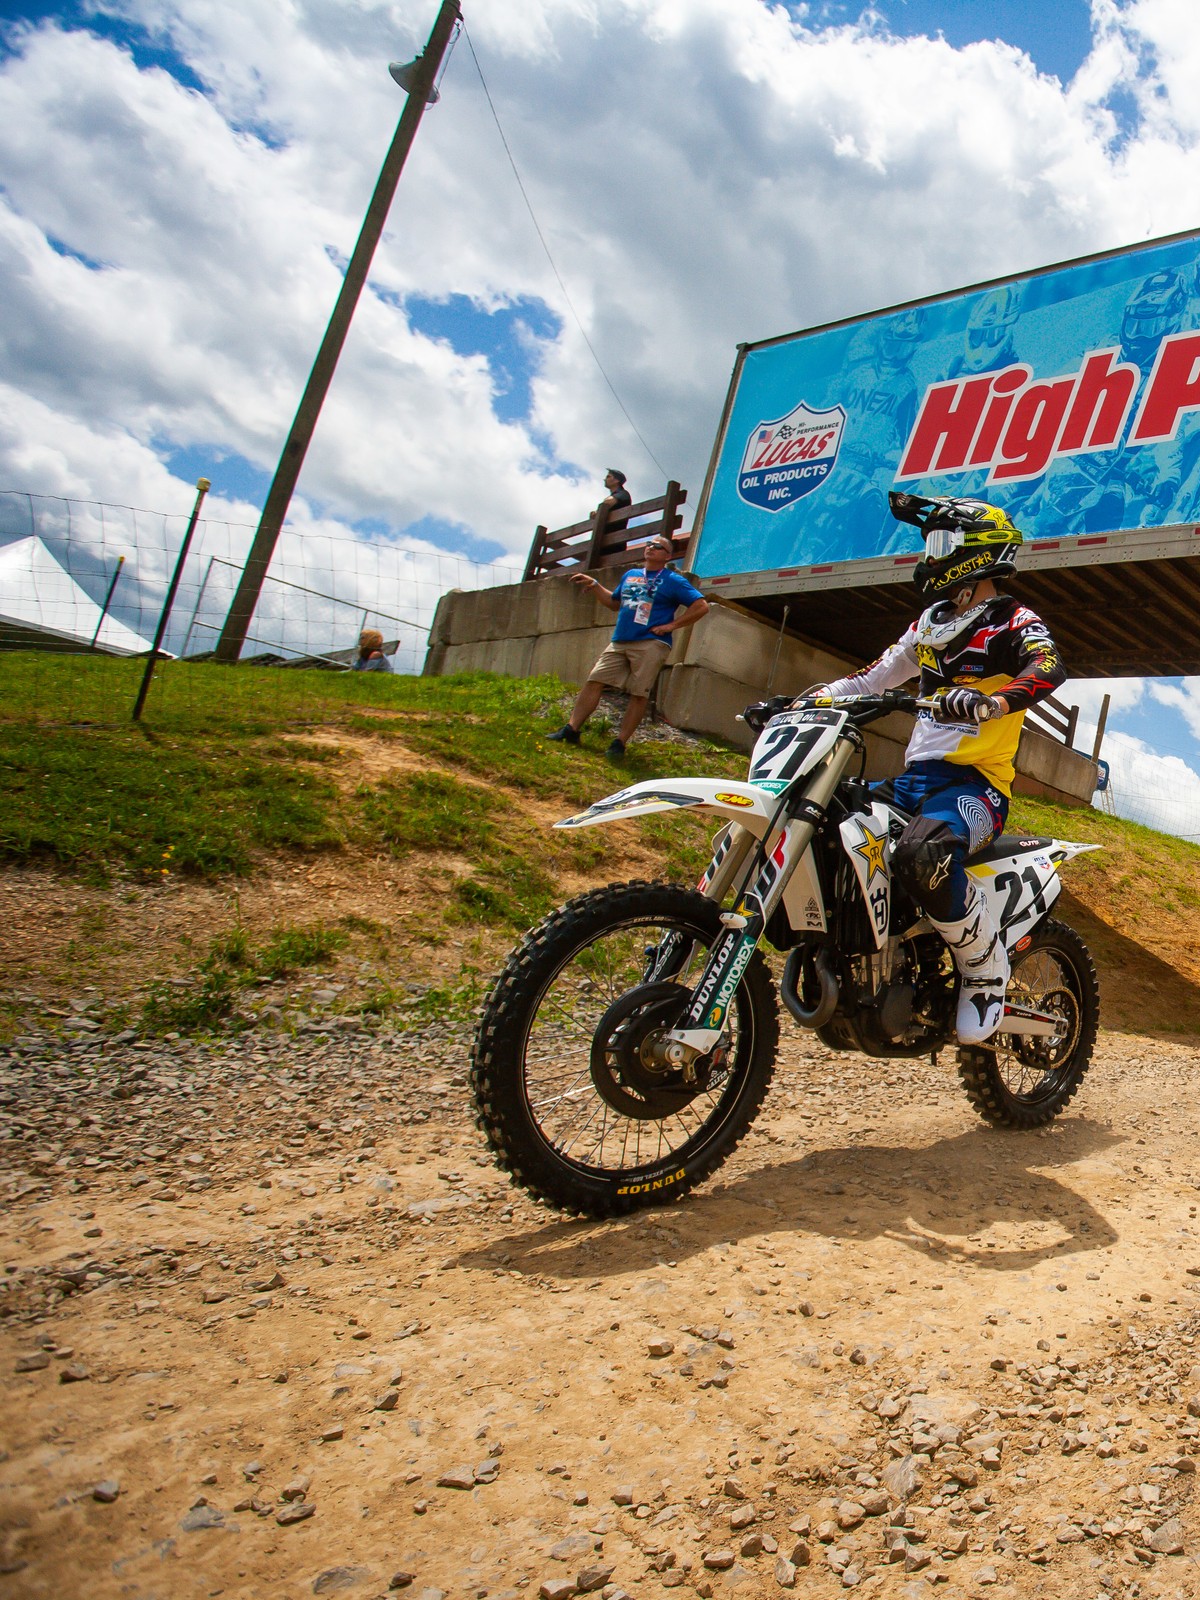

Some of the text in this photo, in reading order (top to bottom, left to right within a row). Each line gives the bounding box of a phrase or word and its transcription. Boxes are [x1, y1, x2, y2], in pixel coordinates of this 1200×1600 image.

[796, 421, 840, 435] PERFORMANCE
[895, 347, 1140, 485] High
[750, 431, 836, 469] LUCAS
[741, 464, 828, 489] OIL PRODUCTS
[768, 487, 792, 500] INC.
[933, 723, 978, 736] FACTORY RACING
[750, 726, 828, 780] 21
[716, 793, 754, 808] FMF
[994, 865, 1048, 930] 21
[690, 932, 736, 1022] DUNLOP
[716, 940, 755, 1008] MOTOREX
[617, 1167, 686, 1195] DUNLOP
